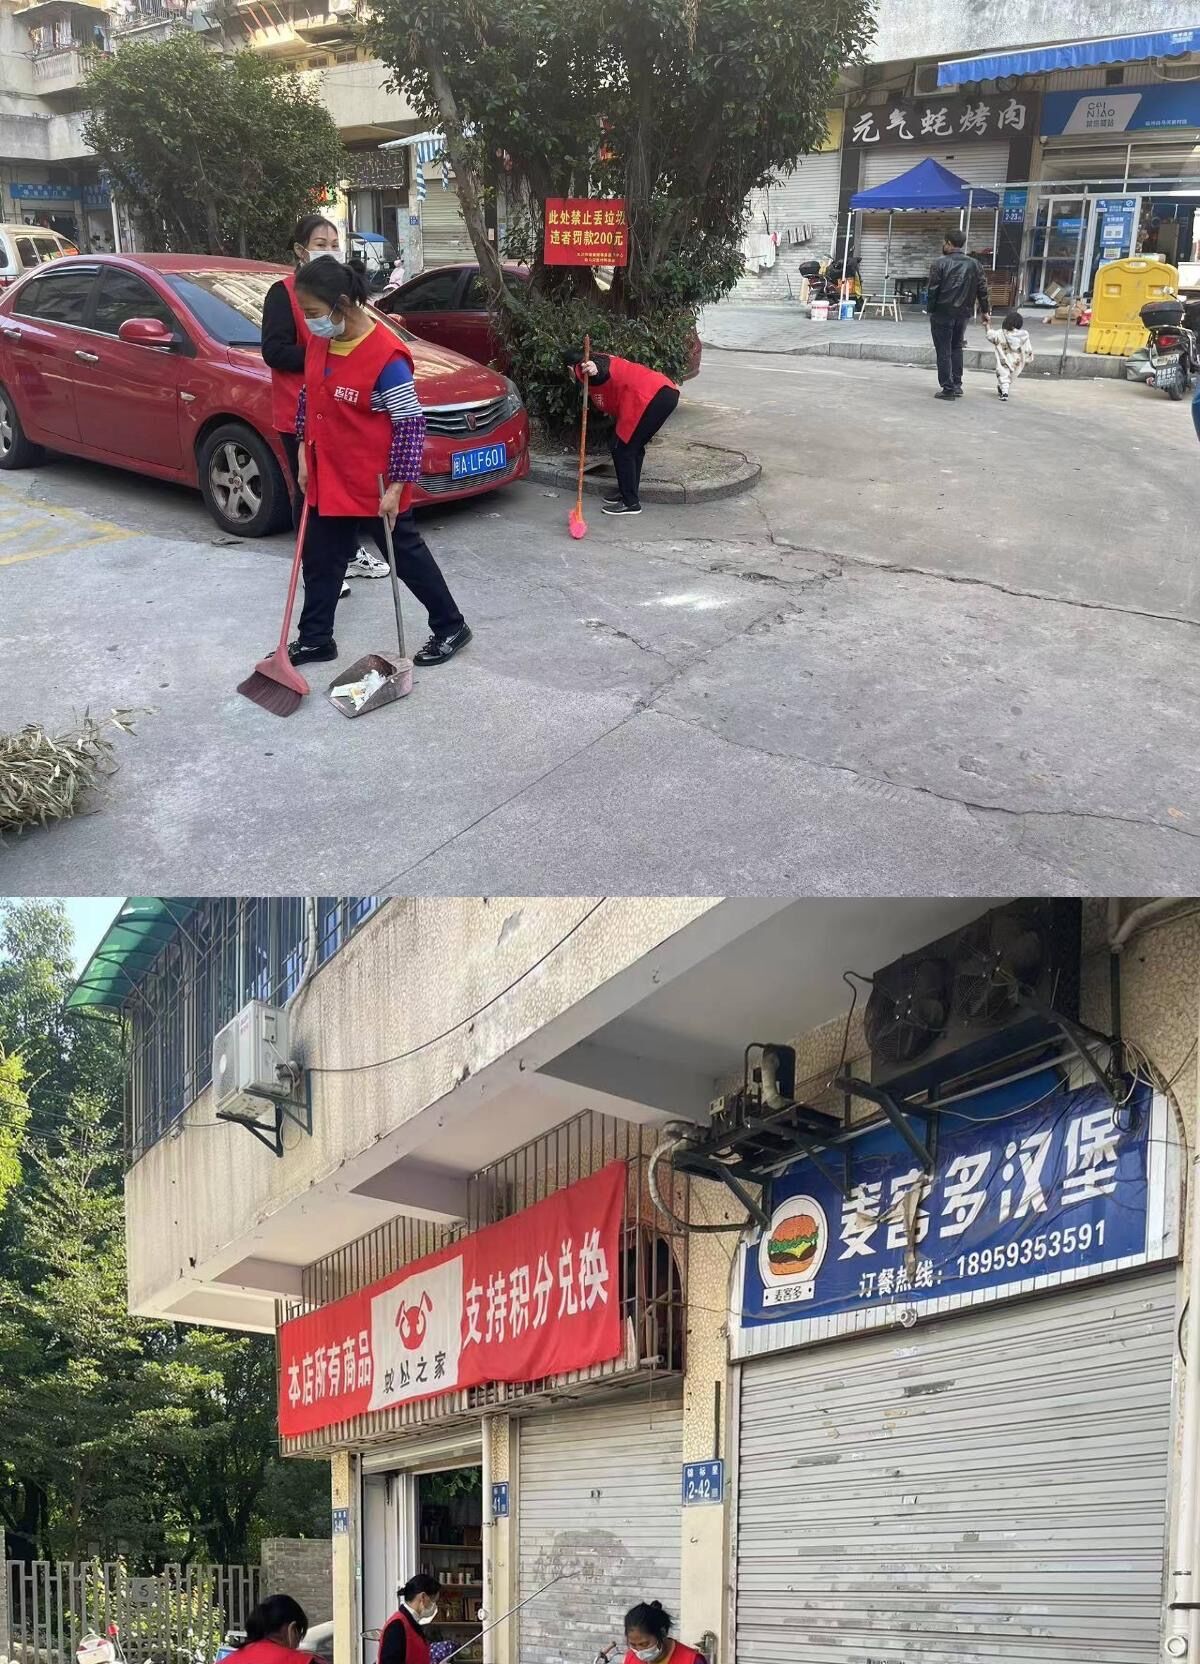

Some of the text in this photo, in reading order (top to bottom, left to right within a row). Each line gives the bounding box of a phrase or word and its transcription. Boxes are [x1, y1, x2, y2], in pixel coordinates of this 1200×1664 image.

[852, 99, 1026, 142] 元气蚝烤肉
[548, 210, 625, 225] 此处禁止丢垃圾
[550, 230, 623, 246] 违者罚款200元
[838, 1107, 1121, 1261] 麦客多汉堡
[956, 1219, 1106, 1279] 18959353591
[775, 1285, 801, 1301] 麦客多
[288, 1227, 609, 1409] 本店所有商品 支持积分兑换
